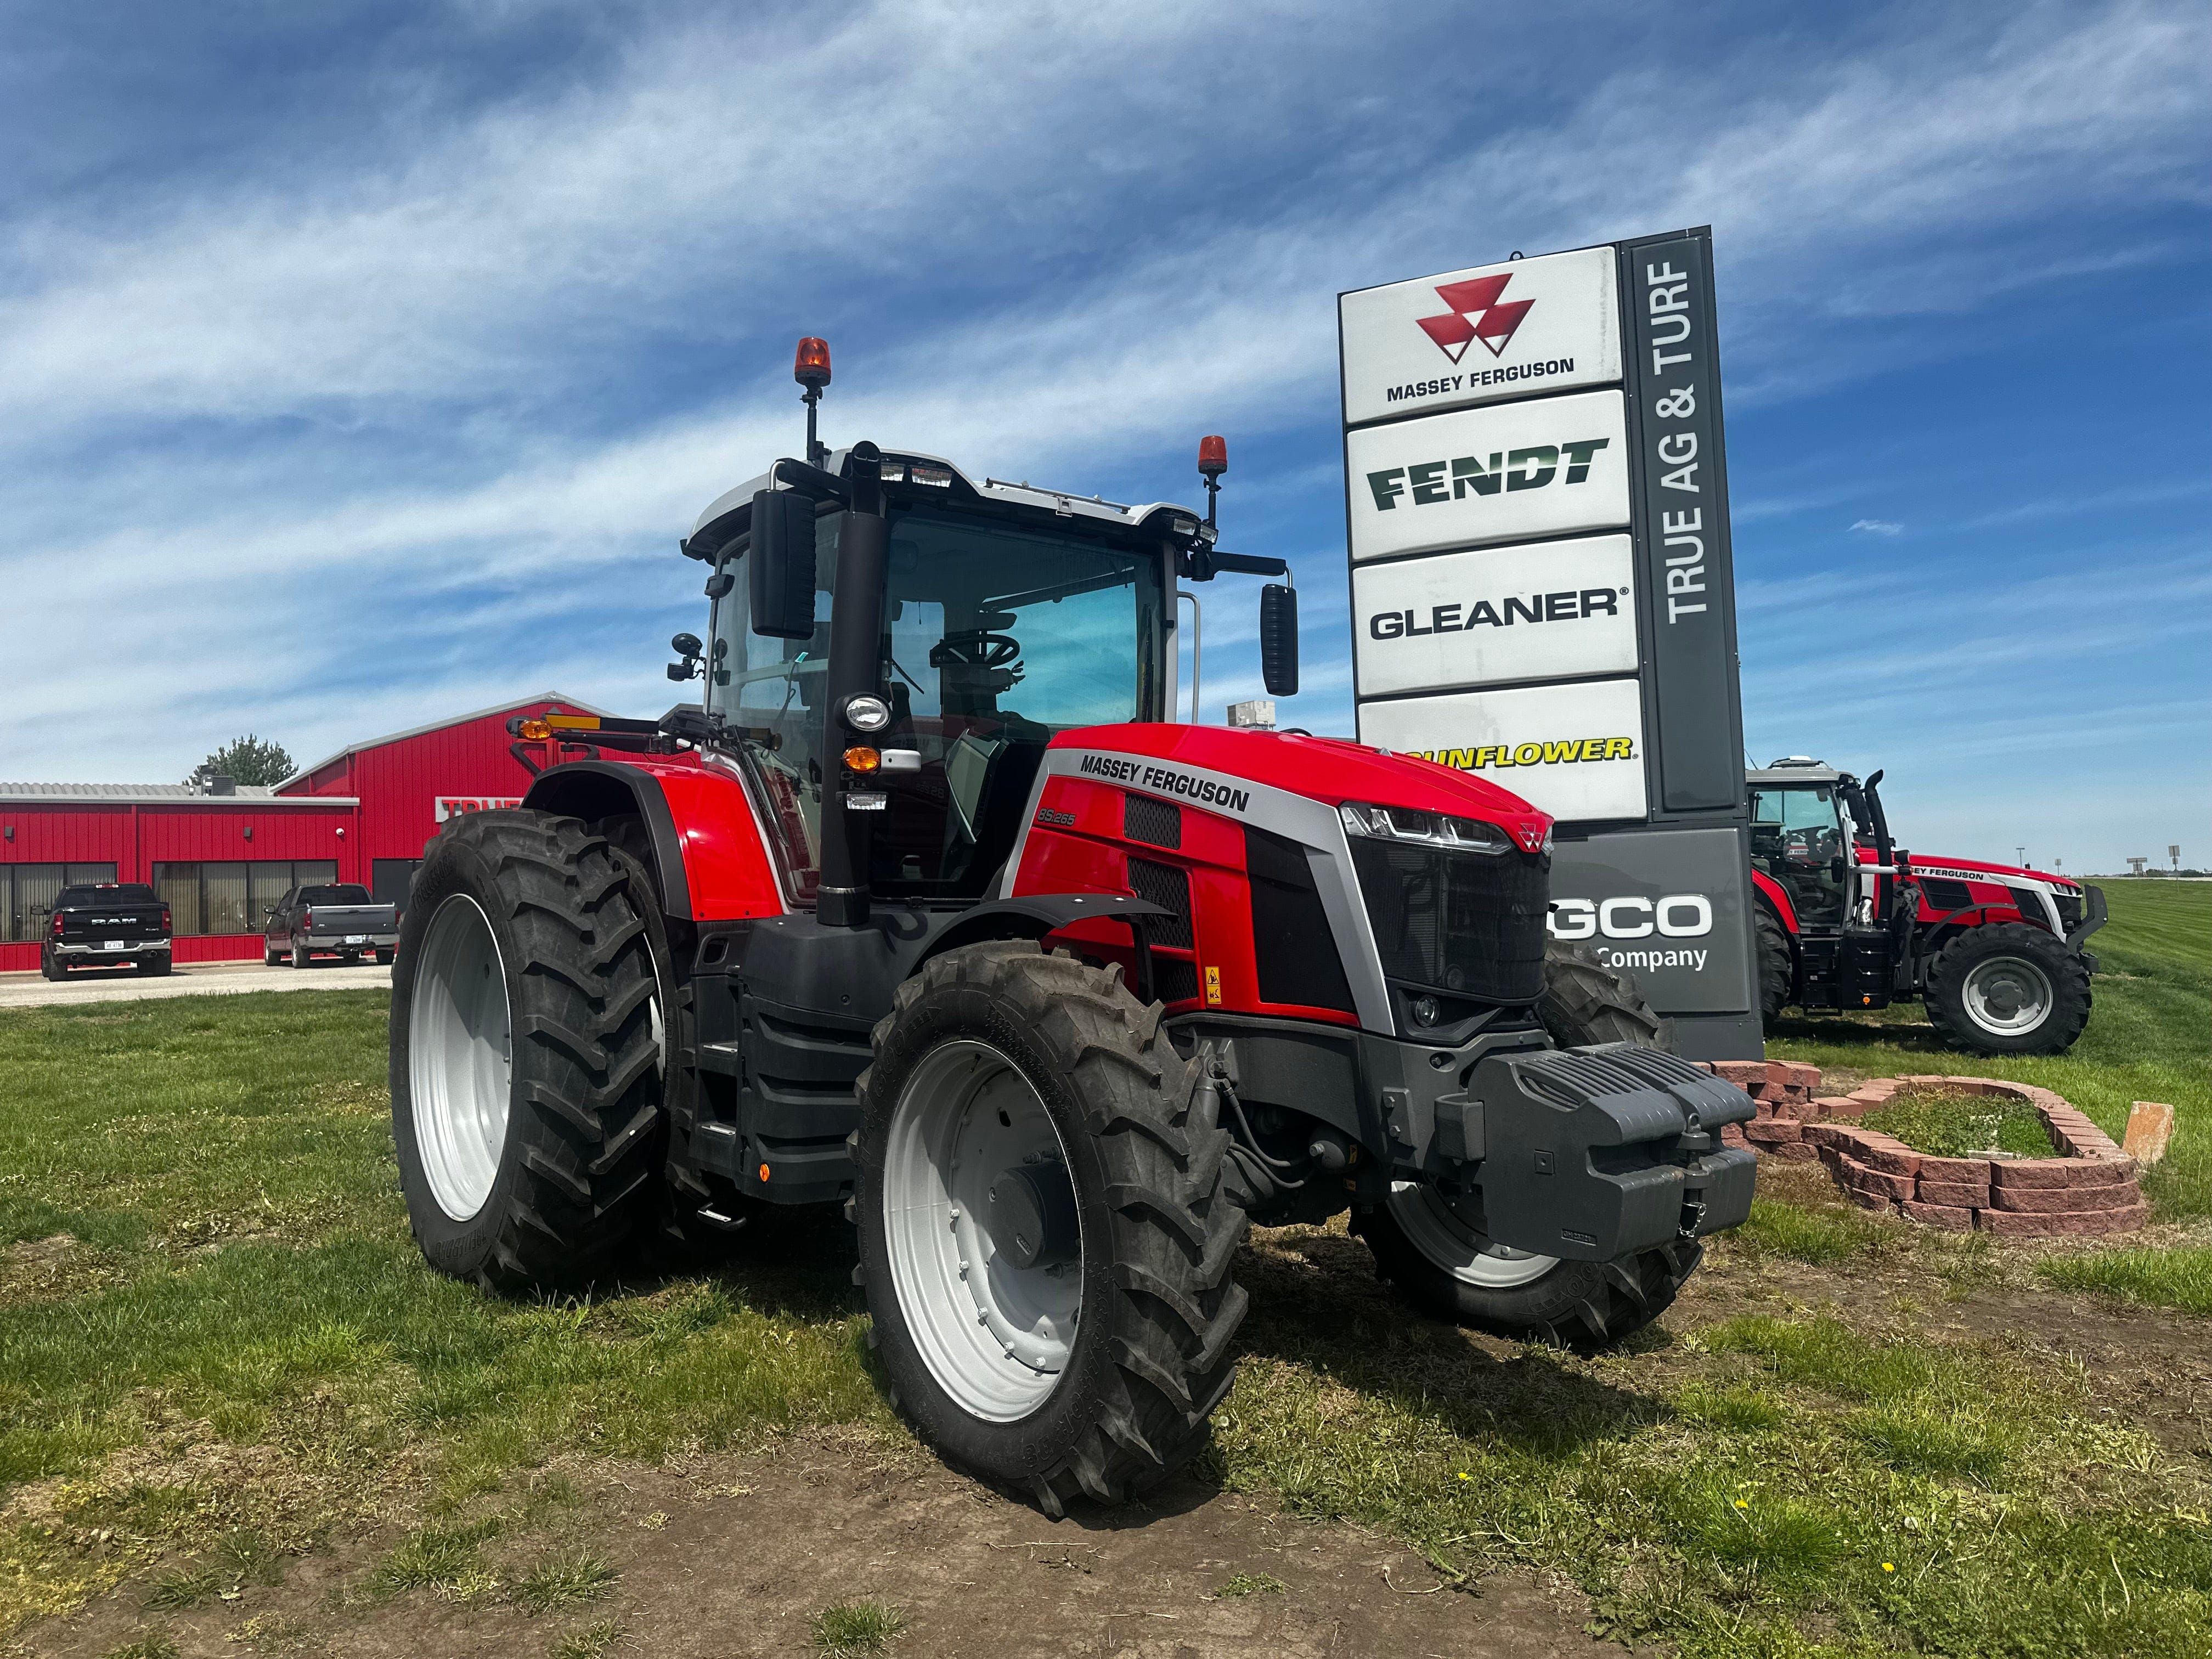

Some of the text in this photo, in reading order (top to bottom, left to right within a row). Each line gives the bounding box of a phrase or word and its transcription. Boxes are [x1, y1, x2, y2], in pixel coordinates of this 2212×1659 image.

[1386, 358, 1575, 402] MASSEY FERGUSON
[1647, 261, 1707, 624] TRUE AG & TURF
[1366, 437, 1611, 511] FENDT
[1080, 755, 1250, 812] MASSEY FERGUSON
[1037, 808, 1077, 827] 8S.265
[1929, 868, 1984, 881] FERGUSON
